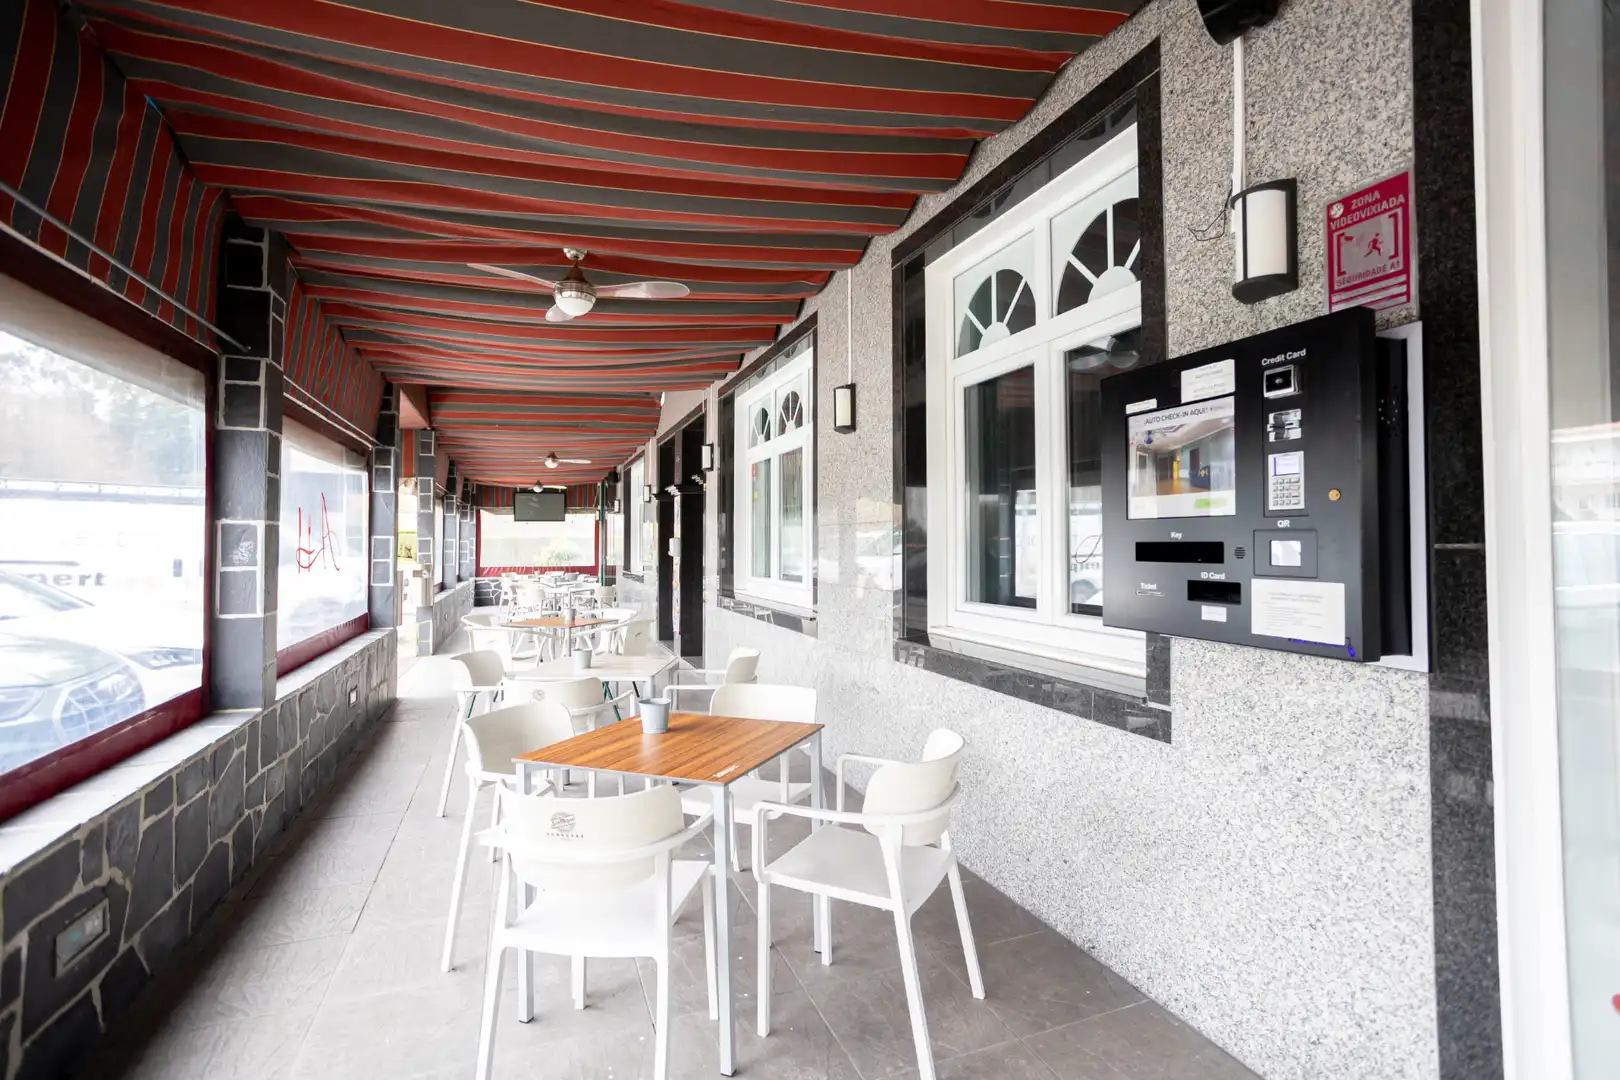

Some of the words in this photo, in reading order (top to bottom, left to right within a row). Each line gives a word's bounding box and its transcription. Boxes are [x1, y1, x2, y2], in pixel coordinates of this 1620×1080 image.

[1351, 191, 1380, 210] ZONA
[1330, 194, 1405, 230] VIDEOVIXIADA
[1261, 353, 1285, 367] Credit
[1286, 348, 1306, 362] Card
[1161, 411, 1189, 421] CHECK-IN
[1277, 519, 1290, 528] QR
[1170, 531, 1183, 540] Key
[1201, 572, 1208, 580] ID
[1210, 572, 1225, 581] Card
[1140, 582, 1157, 590] Ticket
